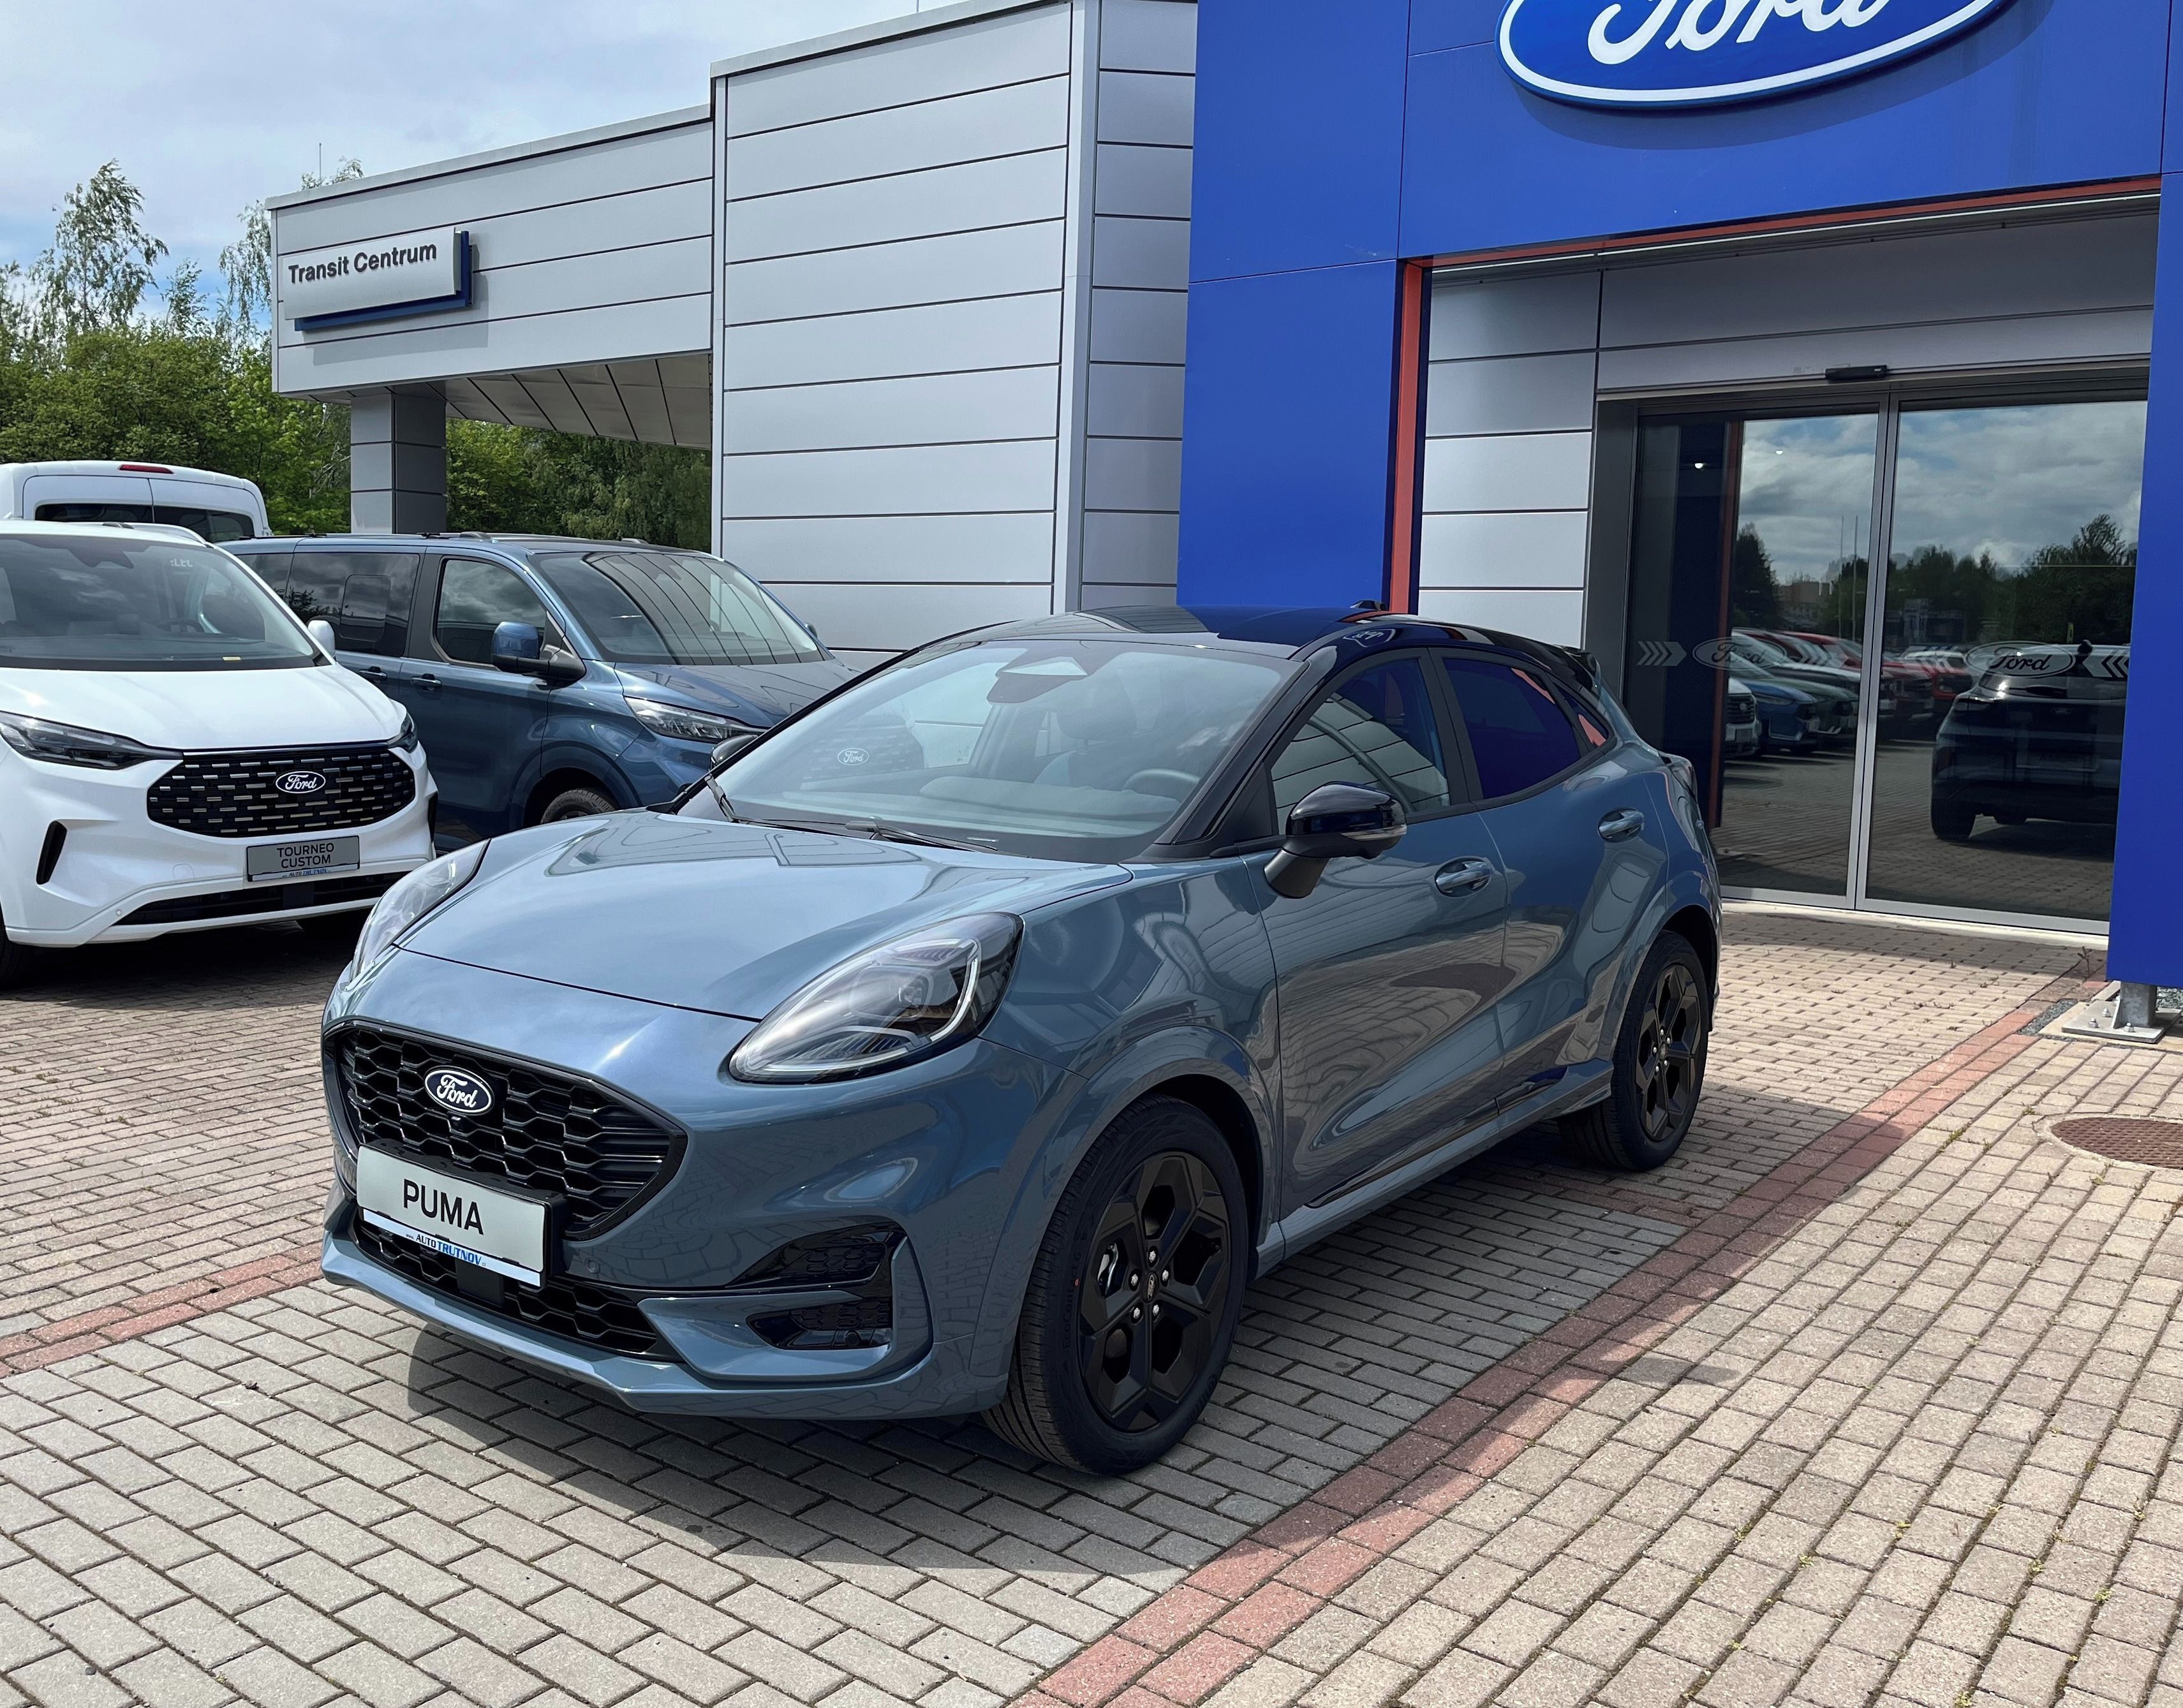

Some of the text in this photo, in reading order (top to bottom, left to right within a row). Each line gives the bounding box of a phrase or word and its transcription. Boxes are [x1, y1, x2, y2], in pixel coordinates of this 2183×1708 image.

[288, 244, 436, 283] Transit Centrum
[1988, 647, 2053, 670] Ford
[843, 750, 864, 762] Ford
[285, 774, 316, 790] Ford
[277, 843, 334, 857] TOURNEO
[281, 854, 331, 868] CUSTOM
[436, 1074, 477, 1108] Ford
[404, 1178, 484, 1235] PUMA
